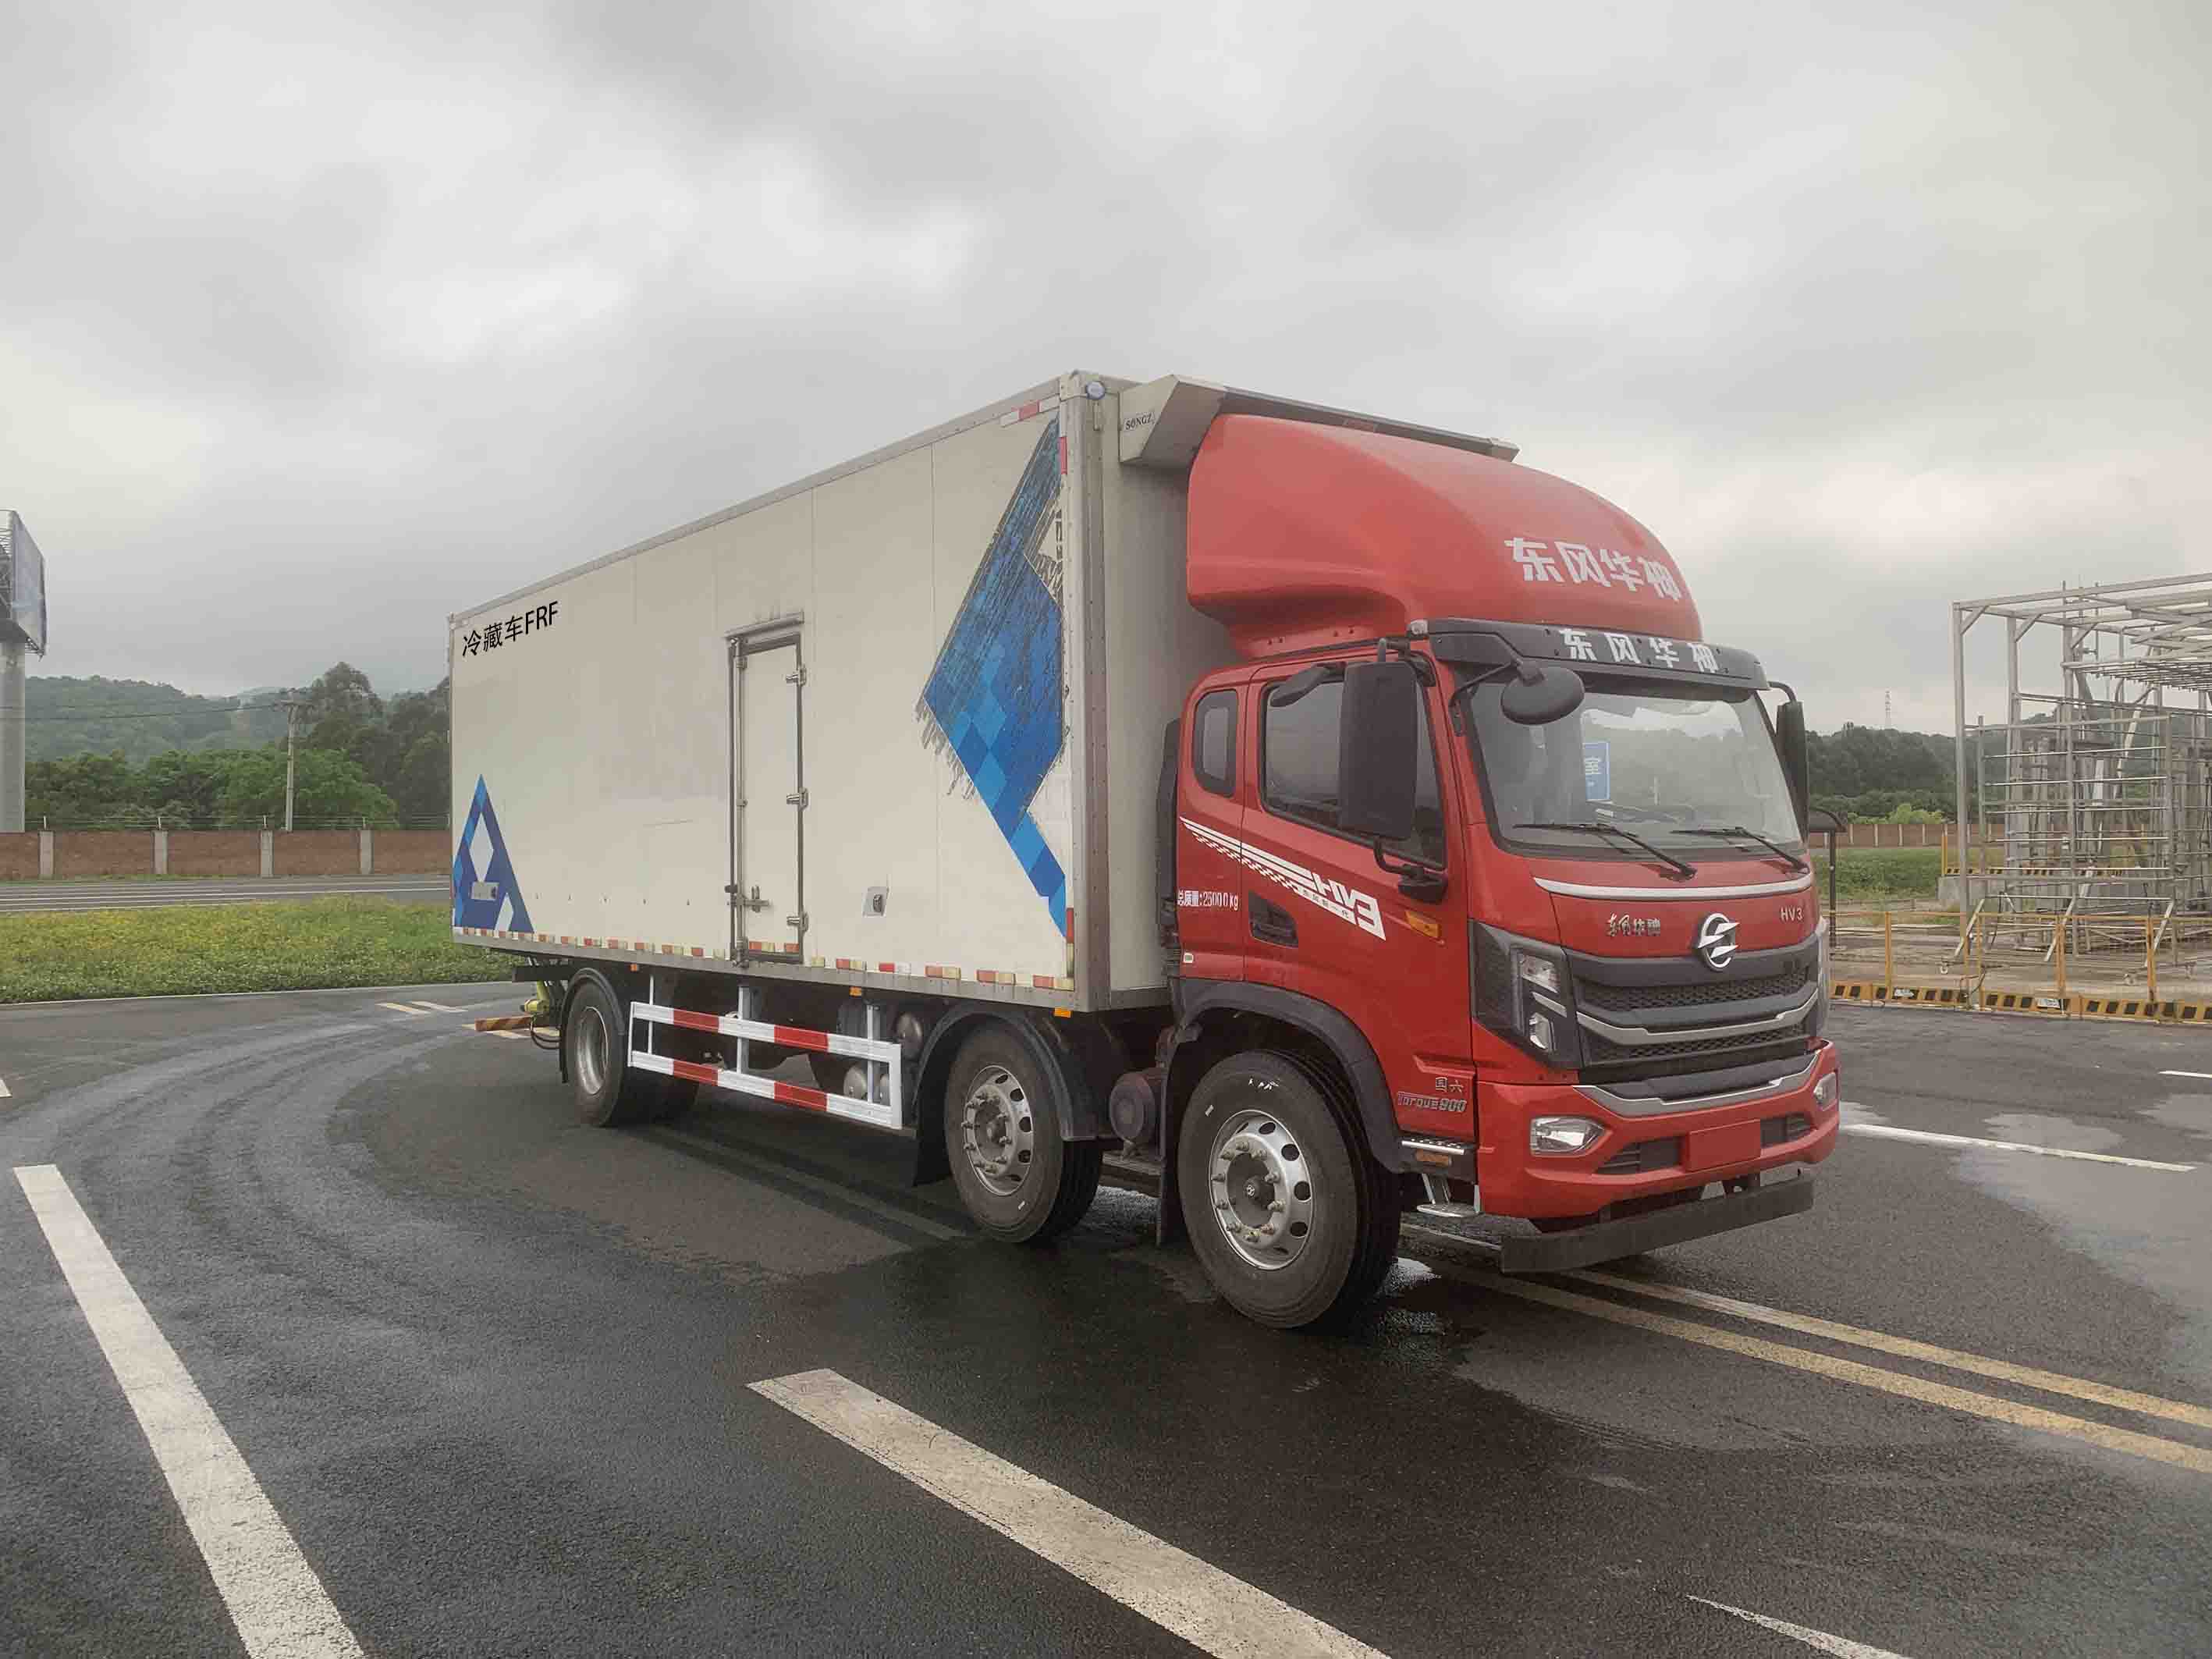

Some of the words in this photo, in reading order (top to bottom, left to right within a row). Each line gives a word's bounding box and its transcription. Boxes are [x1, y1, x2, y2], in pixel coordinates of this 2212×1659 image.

[462, 600, 559, 656] 冷藏车FRF
[1781, 907, 1804, 922] HV3
